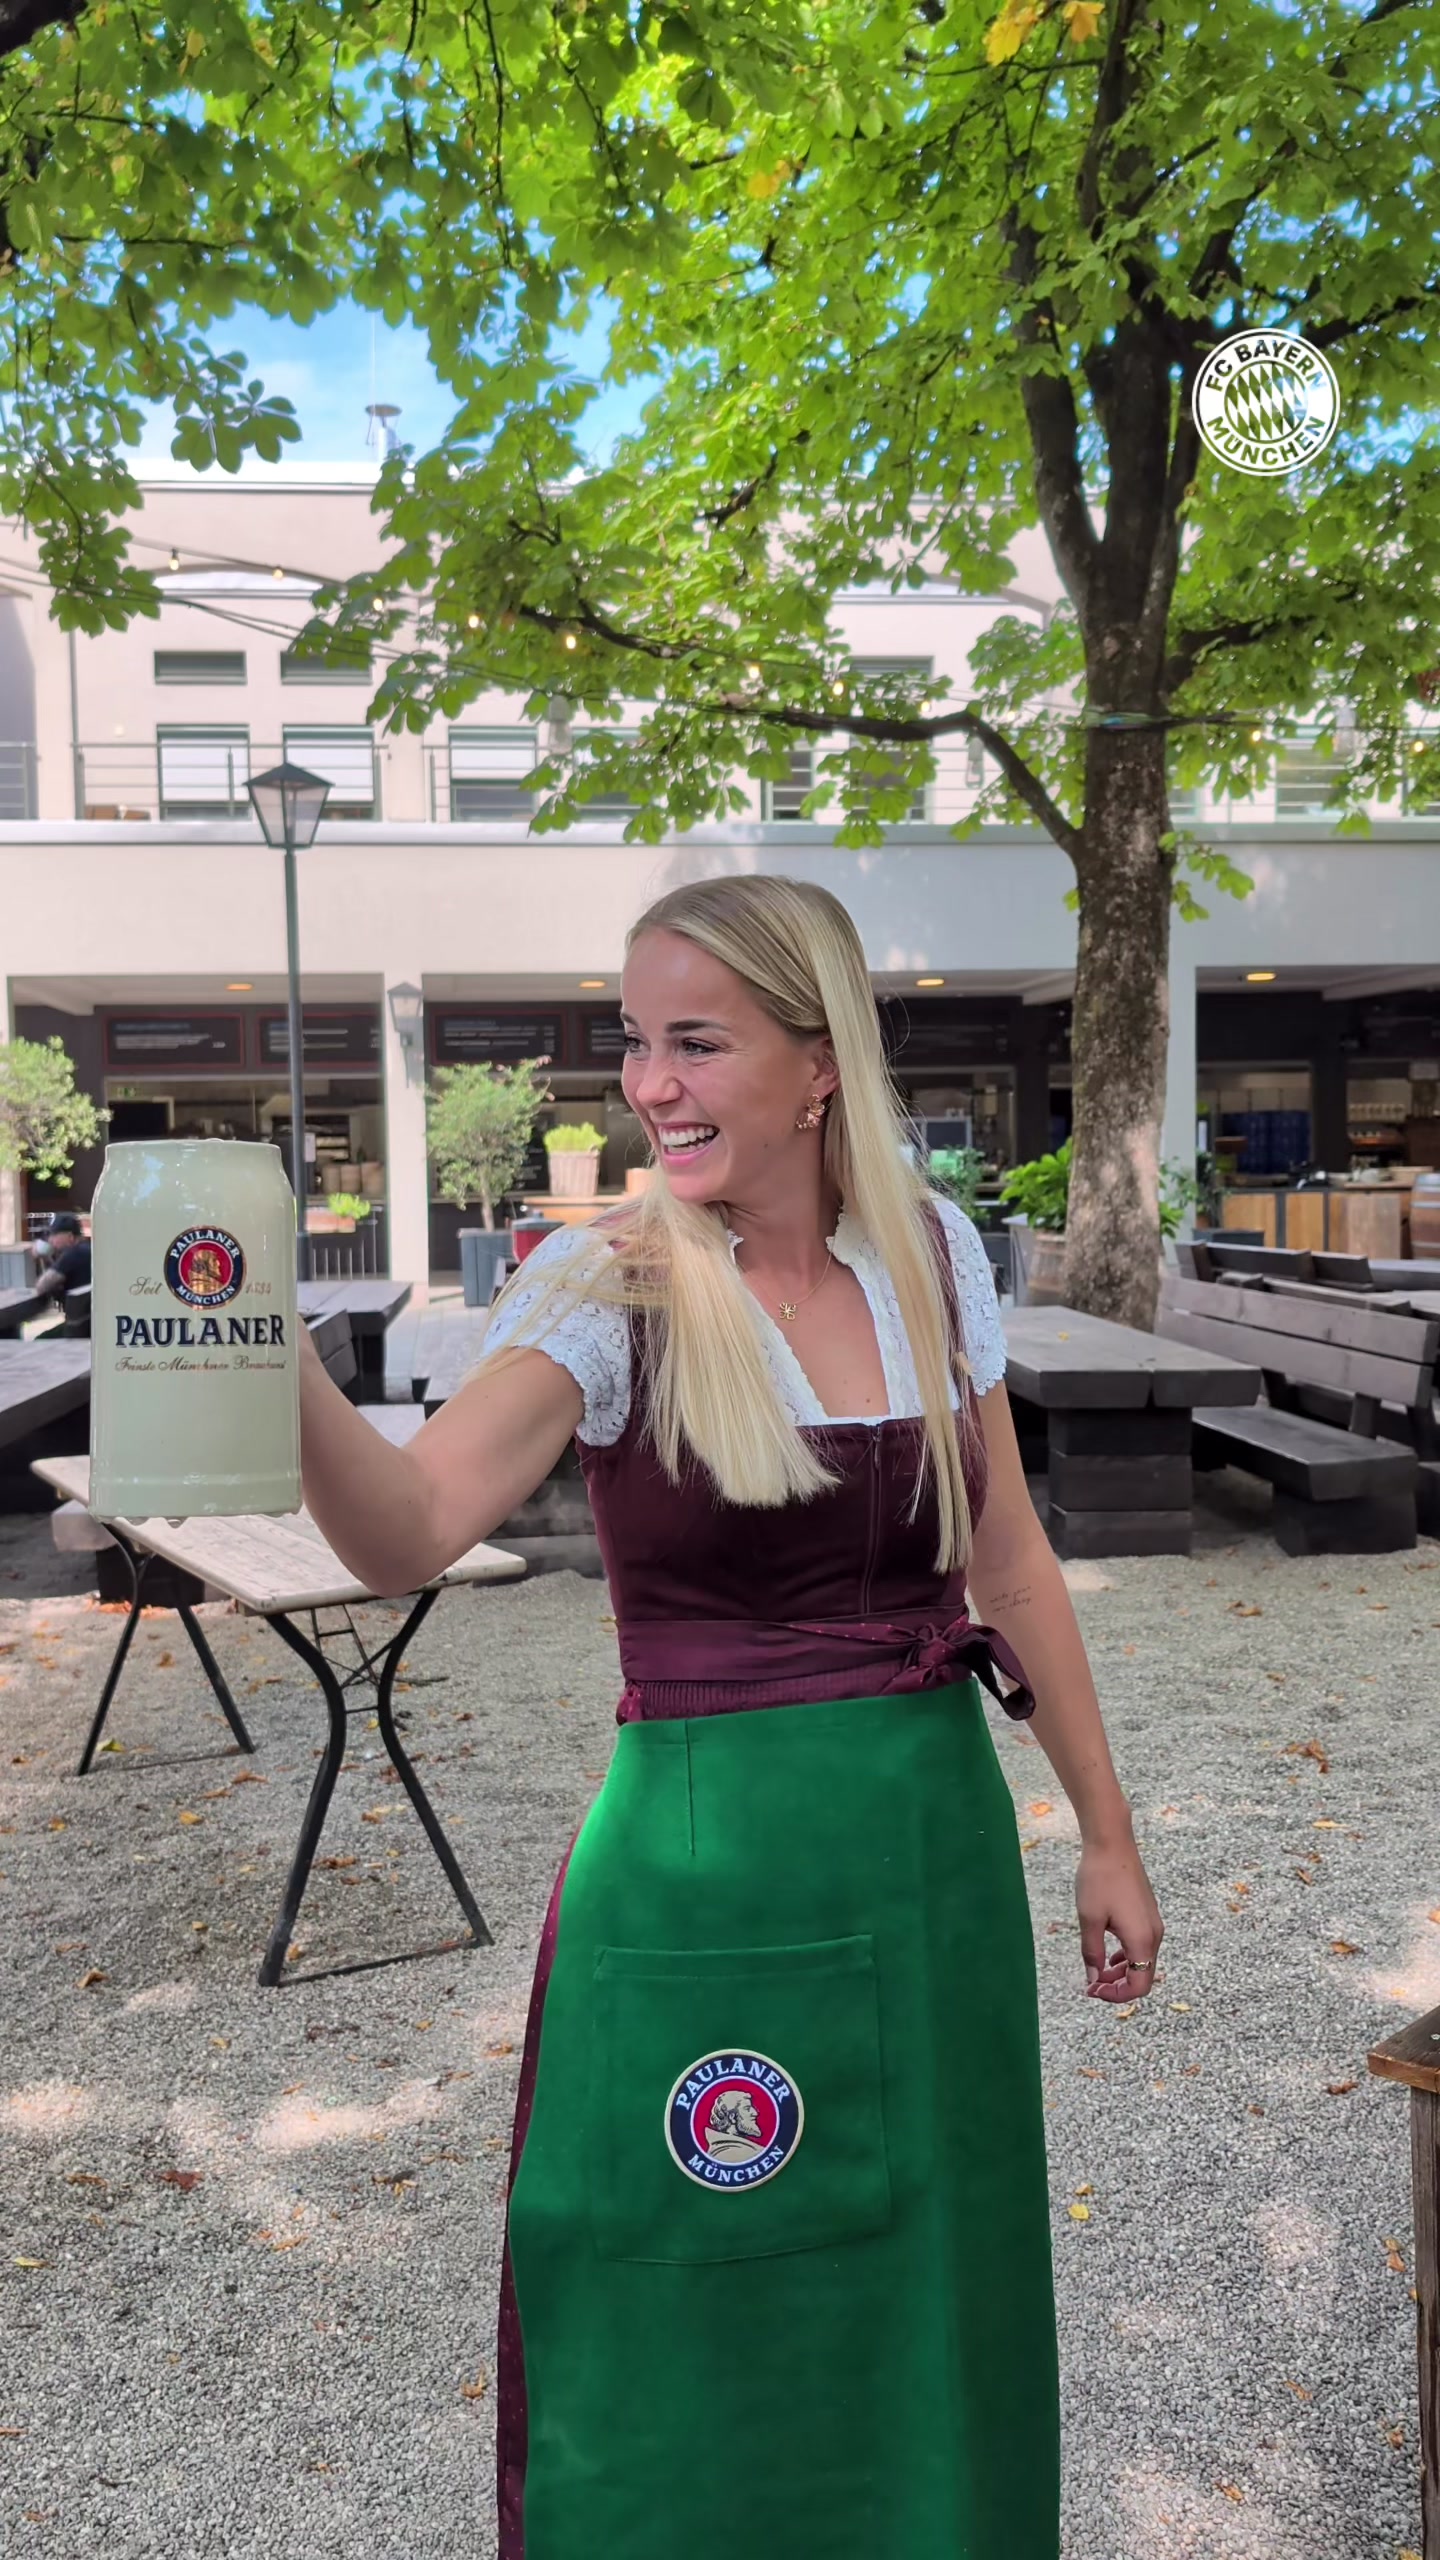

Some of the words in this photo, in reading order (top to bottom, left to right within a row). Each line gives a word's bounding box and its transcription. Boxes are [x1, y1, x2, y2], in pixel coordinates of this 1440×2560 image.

[170, 1229, 240, 1259] PAULANER
[129, 1276, 163, 1296] Seit
[115, 1314, 286, 1348] PAULANER
[676, 2058, 791, 2111] PAULANER
[687, 2145, 785, 2183] MÜNCHEN
